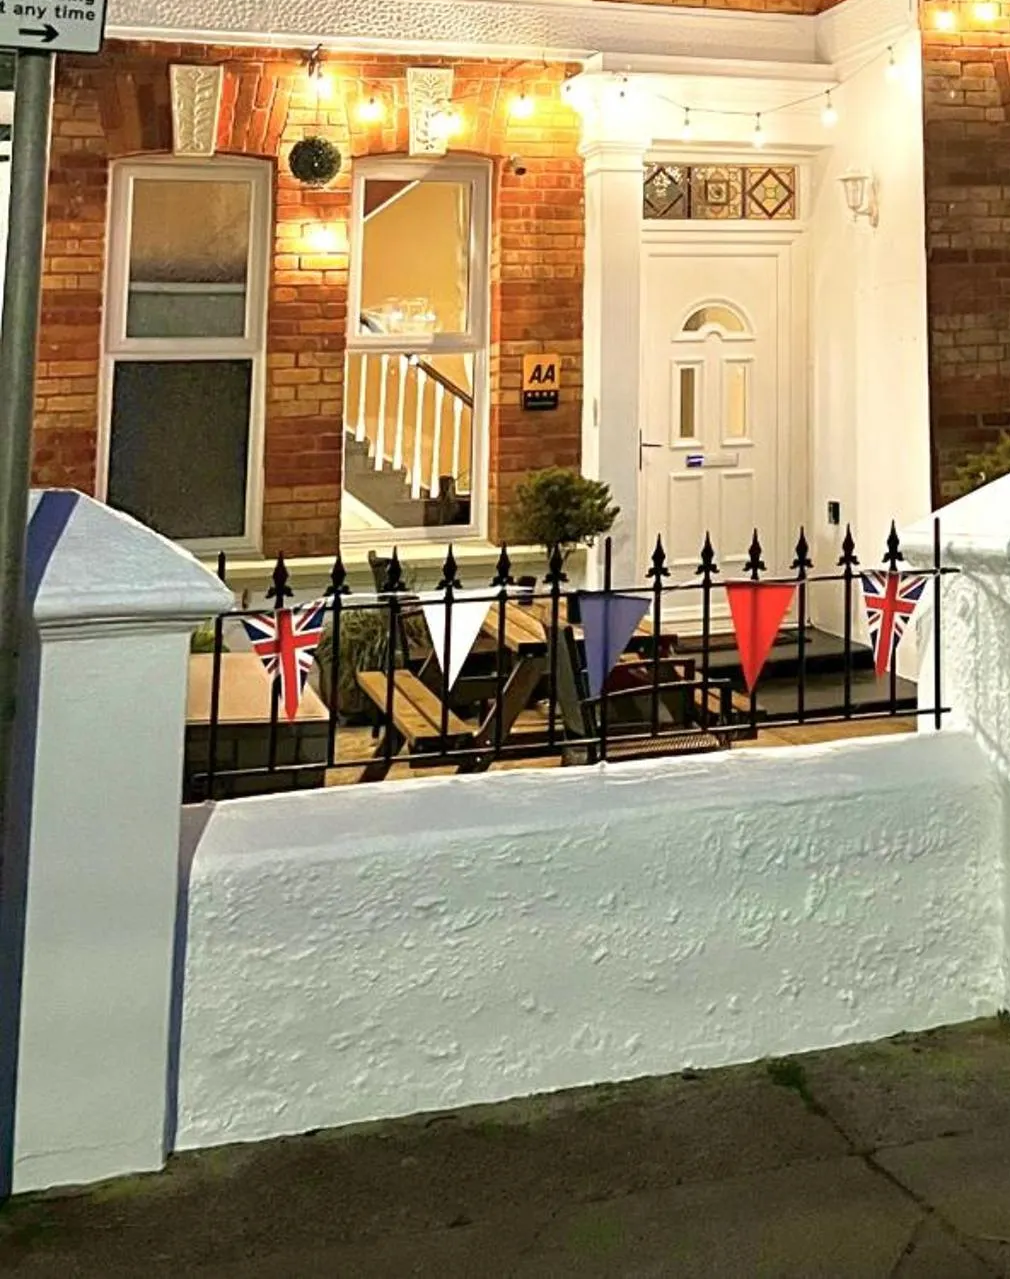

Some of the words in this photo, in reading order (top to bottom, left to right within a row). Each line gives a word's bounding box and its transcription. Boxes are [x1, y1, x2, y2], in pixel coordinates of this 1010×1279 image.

[13, 4, 47, 19] any
[54, 5, 96, 21] time
[528, 363, 556, 384] AA
